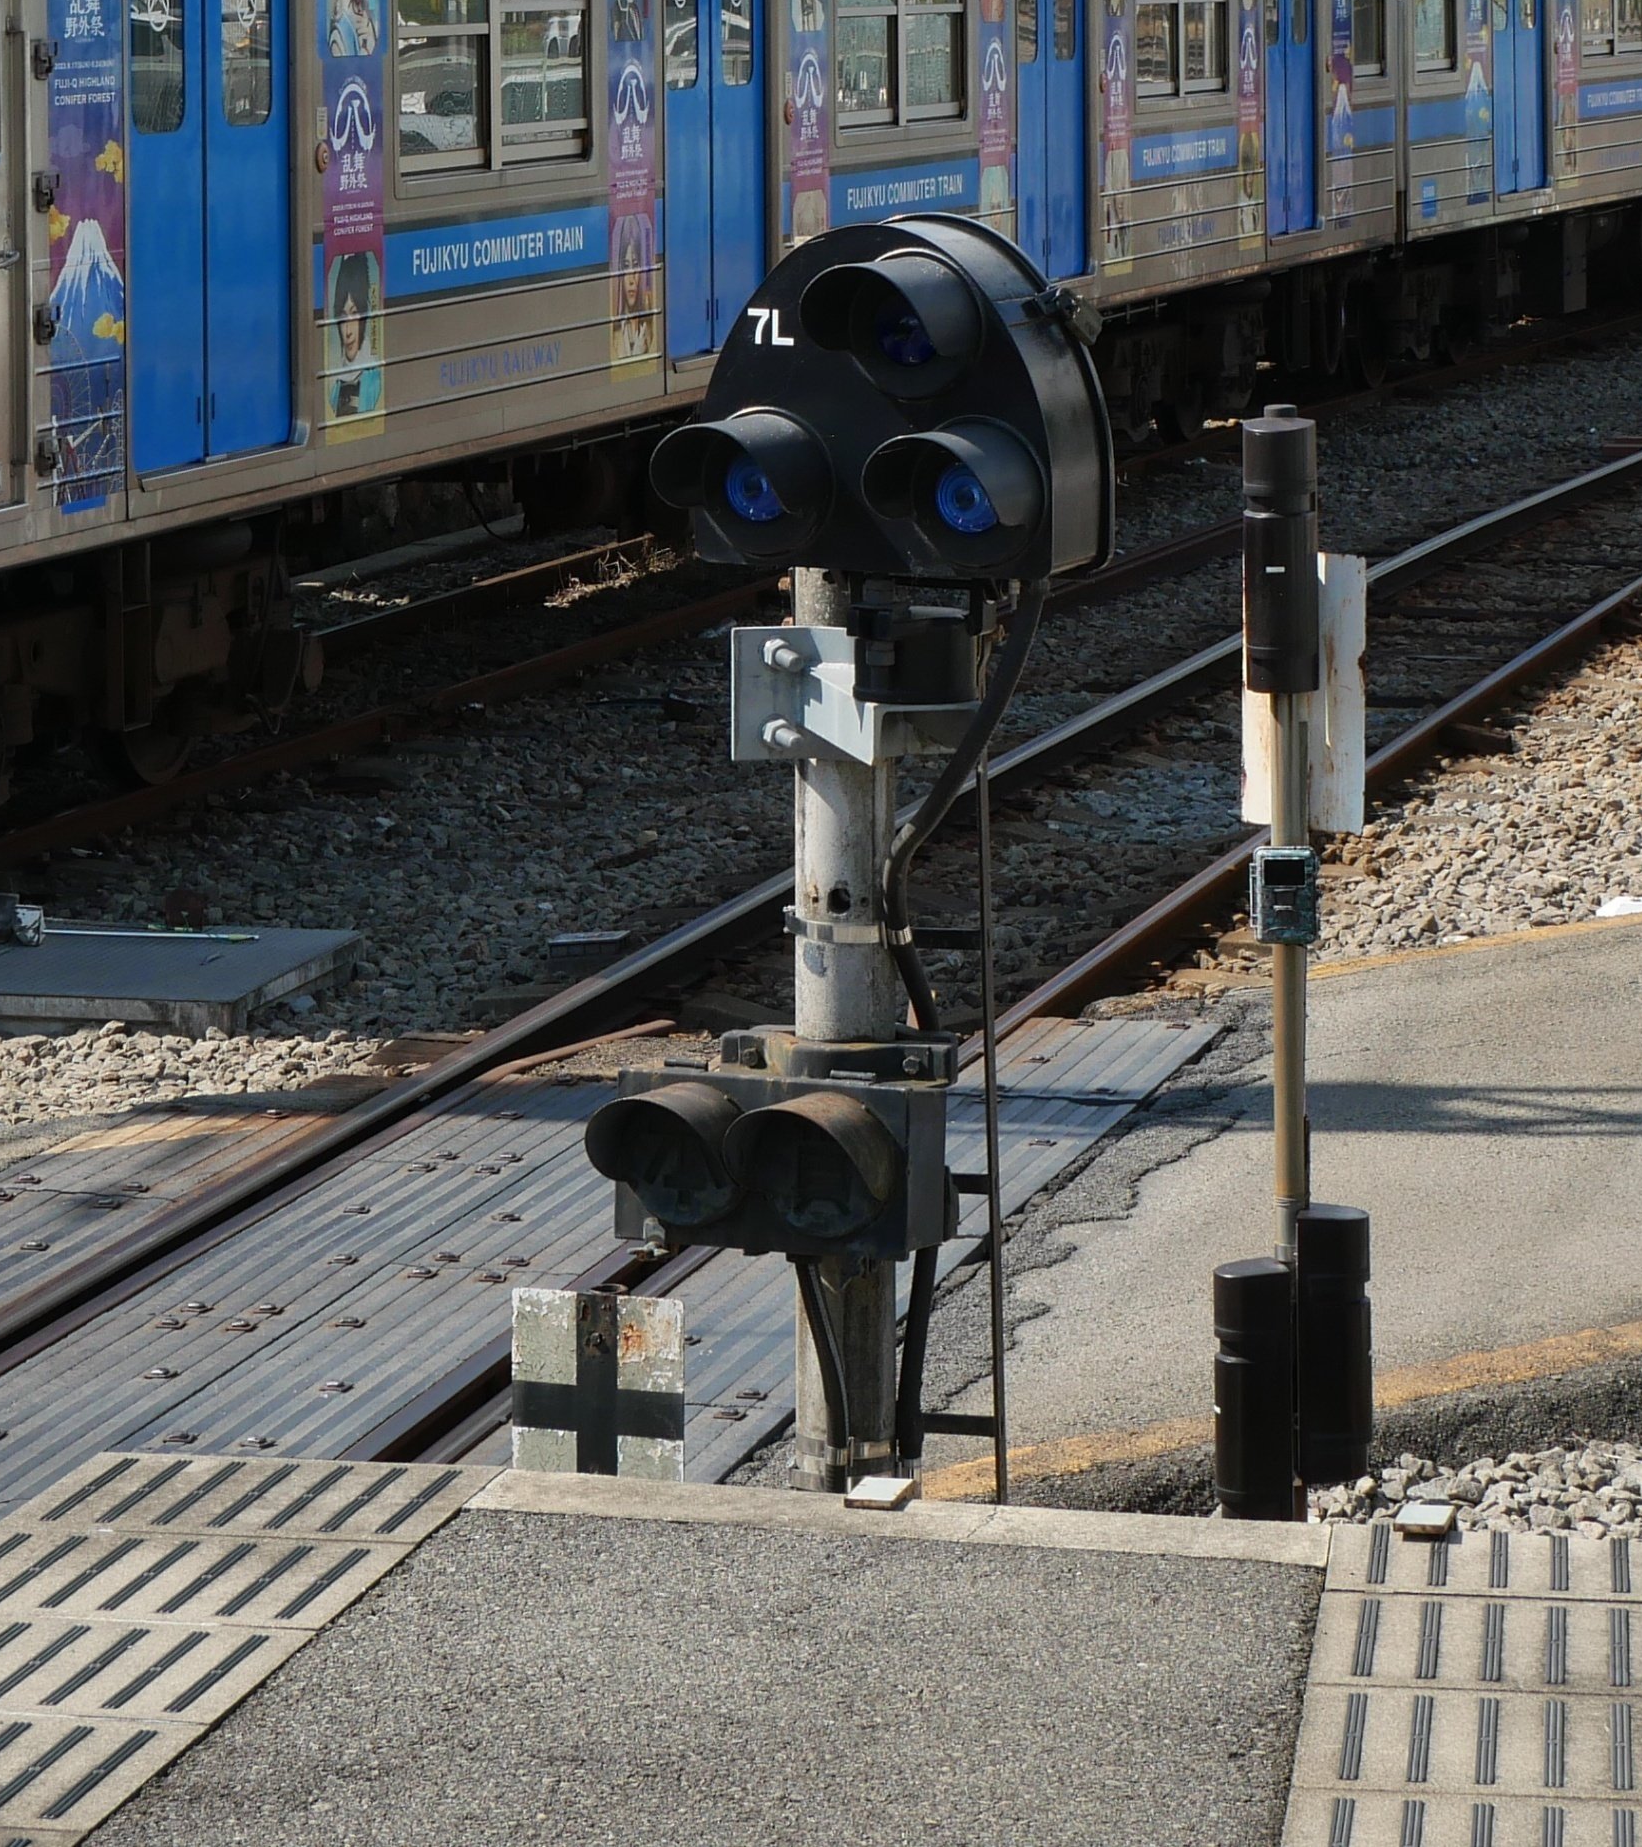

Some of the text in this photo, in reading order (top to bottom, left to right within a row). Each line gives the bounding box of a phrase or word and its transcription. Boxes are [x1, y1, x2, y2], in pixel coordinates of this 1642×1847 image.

[64, 15, 105, 39] 野外祭
[88, 91, 116, 104] FOREST
[847, 174, 963, 210] FUJIKYU COMMUTER TRAIN
[412, 225, 584, 276] FUJIKYU COMMUTER TRAIN
[747, 308, 794, 347] 7L
[440, 341, 562, 387] FUJIKYU RAILWAY
